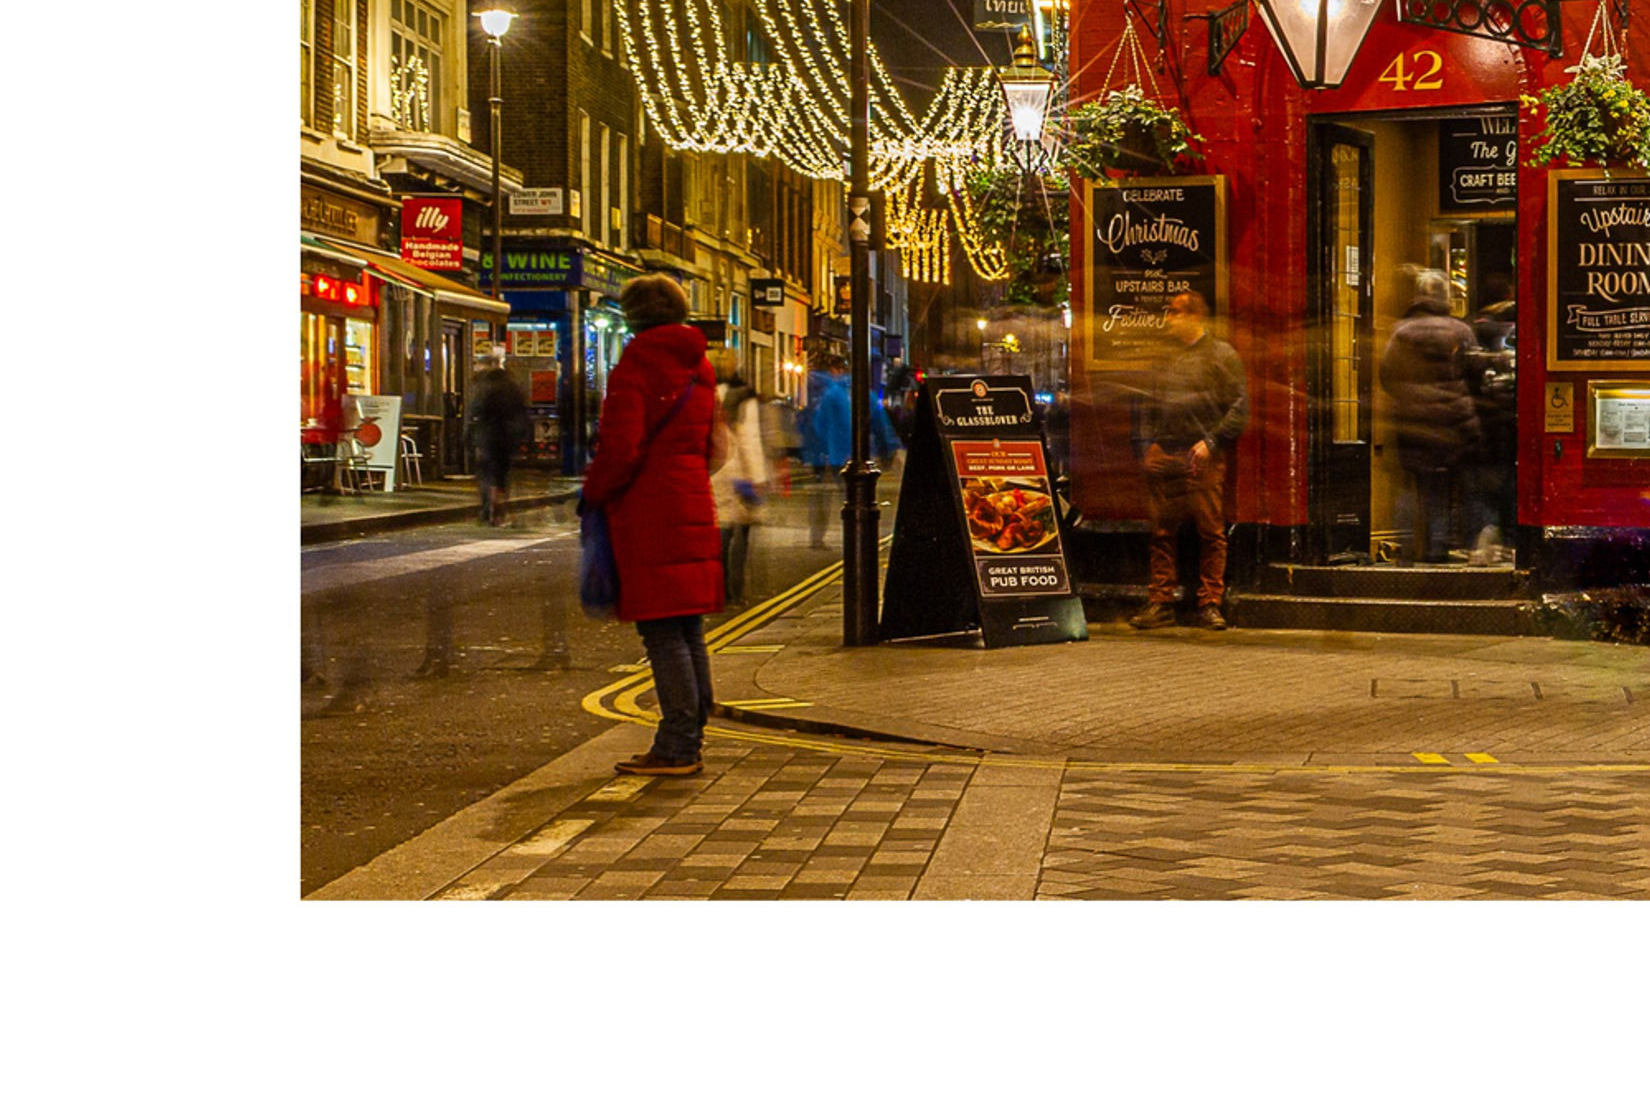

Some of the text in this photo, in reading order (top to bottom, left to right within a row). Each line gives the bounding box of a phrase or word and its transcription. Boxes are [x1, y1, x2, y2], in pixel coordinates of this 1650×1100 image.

[1378, 50, 1443, 91] 42
[1470, 141, 1499, 159] The
[1460, 175, 1494, 187] CRAFT
[1123, 189, 1184, 202] CELEBRATE
[1593, 185, 1616, 195] RELAX
[415, 206, 449, 233] illy
[1097, 210, 1200, 254] Christmas
[405, 242, 459, 251] Handmade
[412, 250, 451, 259] Belgian
[507, 252, 571, 269] WINE
[1115, 281, 1192, 293] UPSTAIRS BAR
[1102, 304, 1158, 332] Festive
[1582, 316, 1600, 327] FULL
[1604, 313, 1627, 326] TABLE
[976, 405, 994, 415] THE
[957, 415, 1018, 426] GLASSBLOWER
[990, 575, 1058, 586] PUB FOOD
